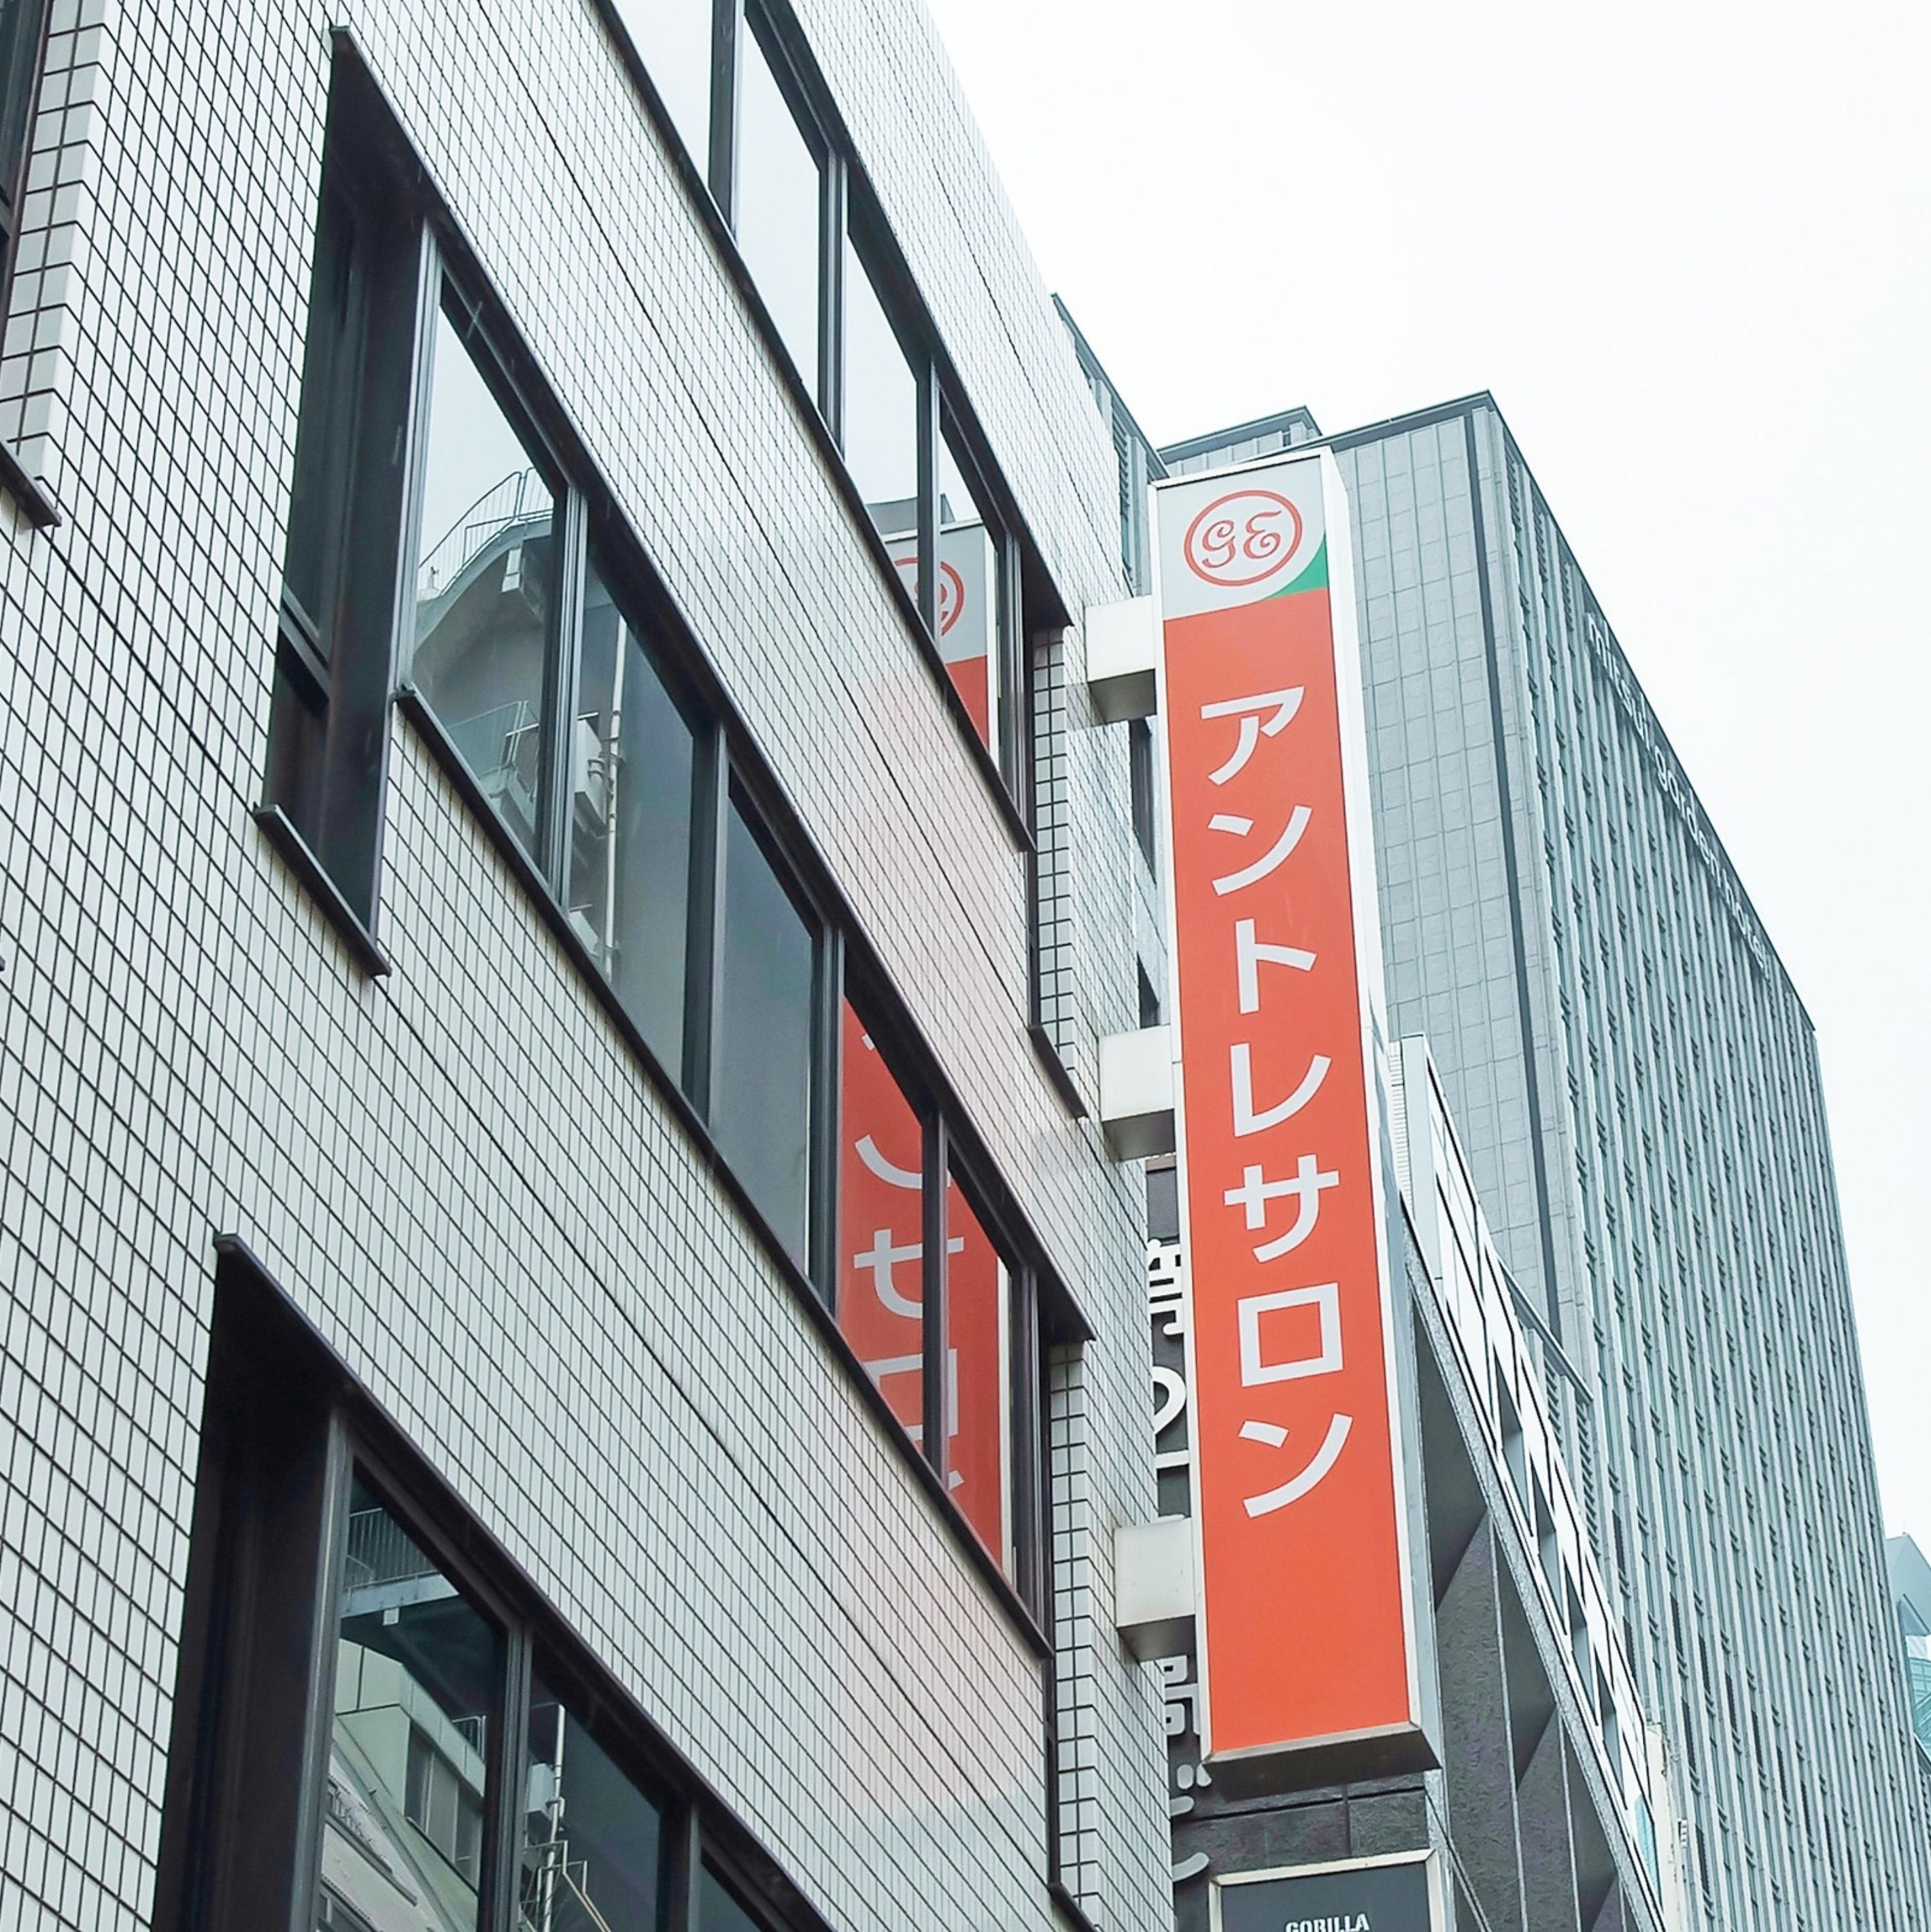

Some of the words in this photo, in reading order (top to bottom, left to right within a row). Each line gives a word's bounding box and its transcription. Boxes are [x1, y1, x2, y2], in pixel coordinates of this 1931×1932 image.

[1588, 613, 1651, 751] mitsui
[1654, 745, 1722, 888] garden
[1722, 868, 1769, 980] hotel
[1201, 685, 1353, 1519] アントレサロン
[1285, 1912, 1370, 1932] GORILLA
